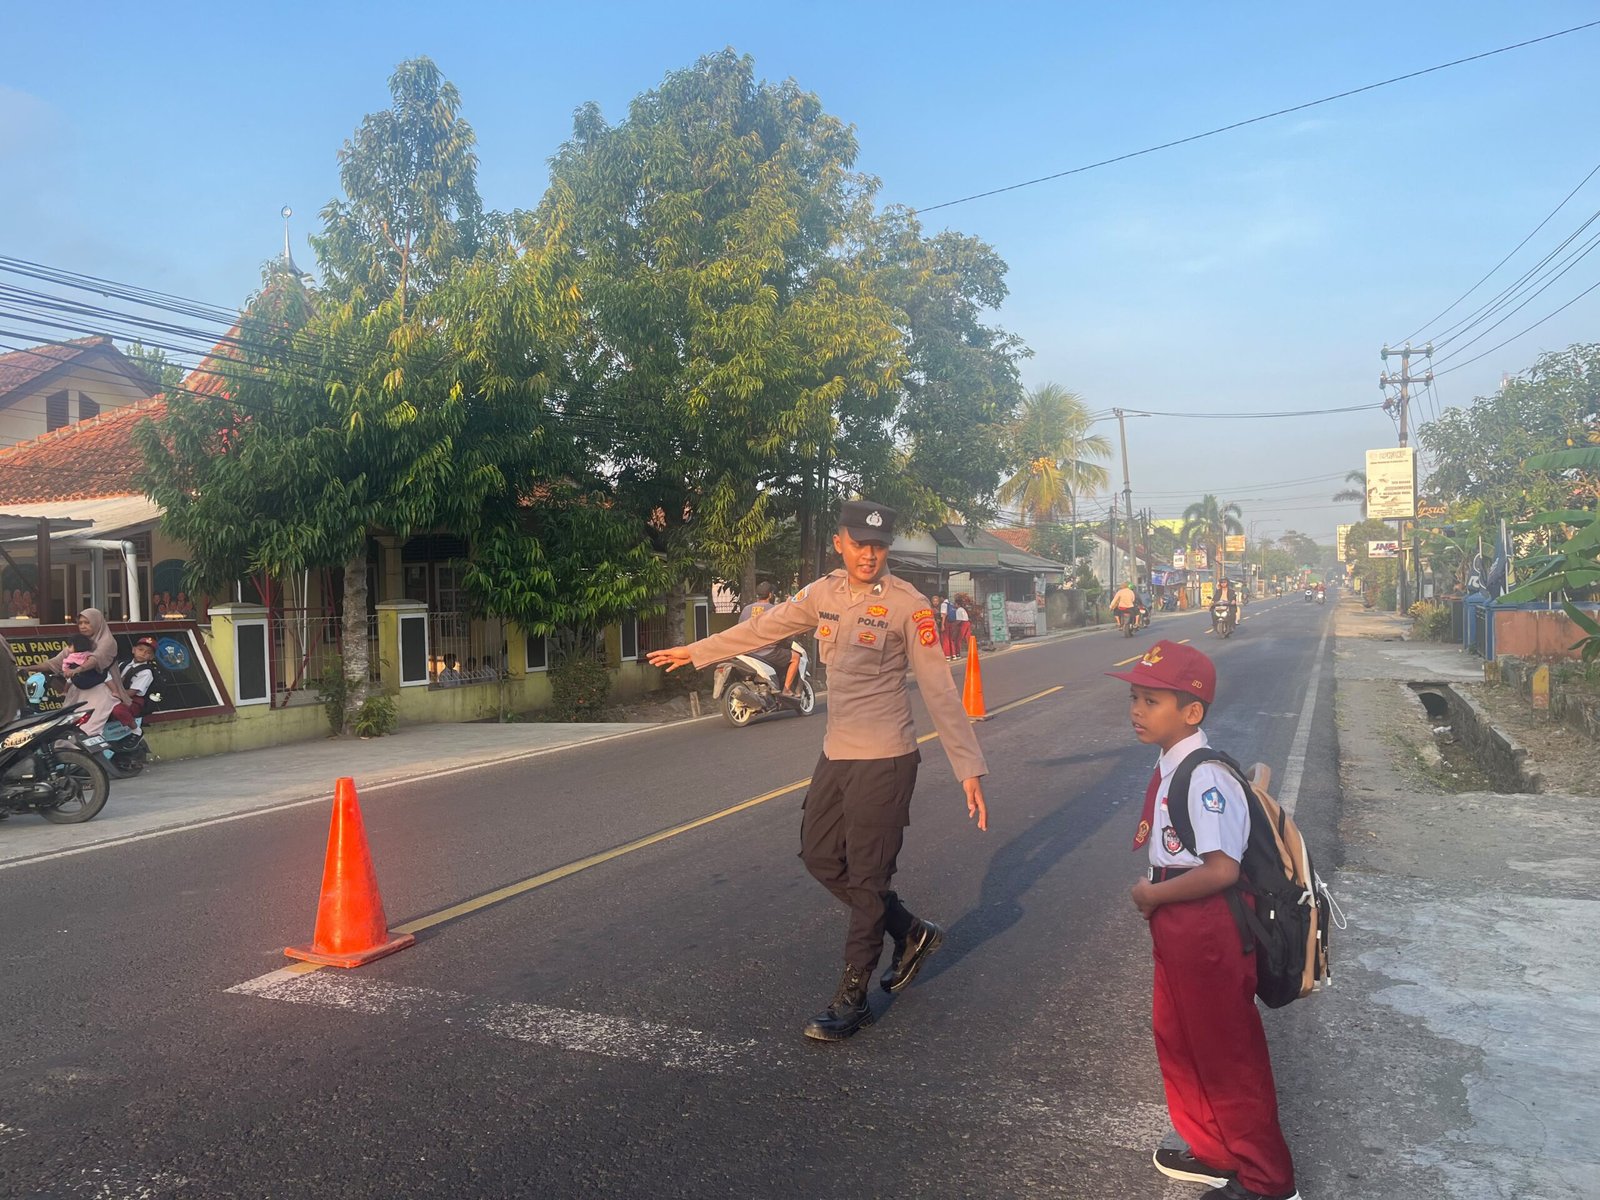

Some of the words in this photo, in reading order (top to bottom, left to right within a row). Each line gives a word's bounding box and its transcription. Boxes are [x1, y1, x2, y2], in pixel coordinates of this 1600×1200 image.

[857, 617, 889, 629] POLRI
[10, 642, 28, 653] EN
[30, 640, 69, 653] PANGA
[39, 701, 64, 711] Sida
